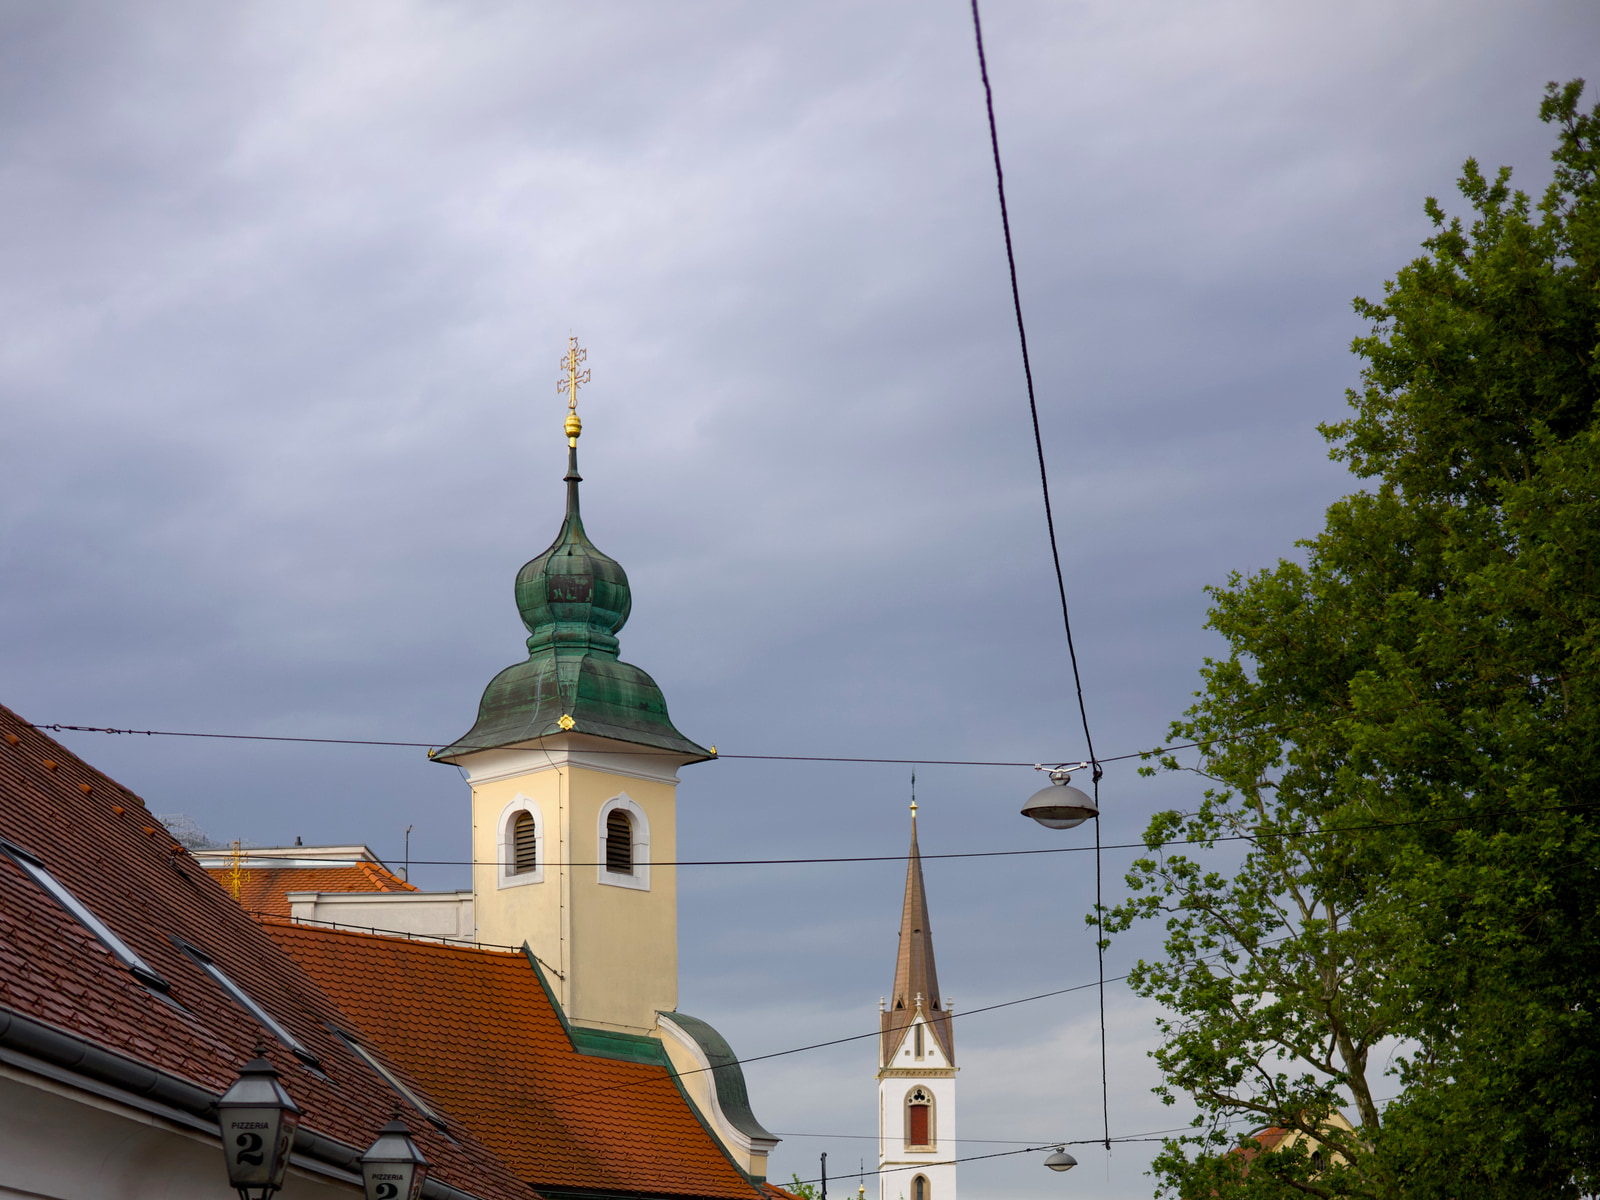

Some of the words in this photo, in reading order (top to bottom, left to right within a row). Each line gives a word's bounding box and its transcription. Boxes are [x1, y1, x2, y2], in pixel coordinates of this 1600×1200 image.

[231, 1121, 269, 1130] PIZZERIA
[236, 1132, 264, 1166] 2
[371, 1173, 404, 1181] PIZZERIA
